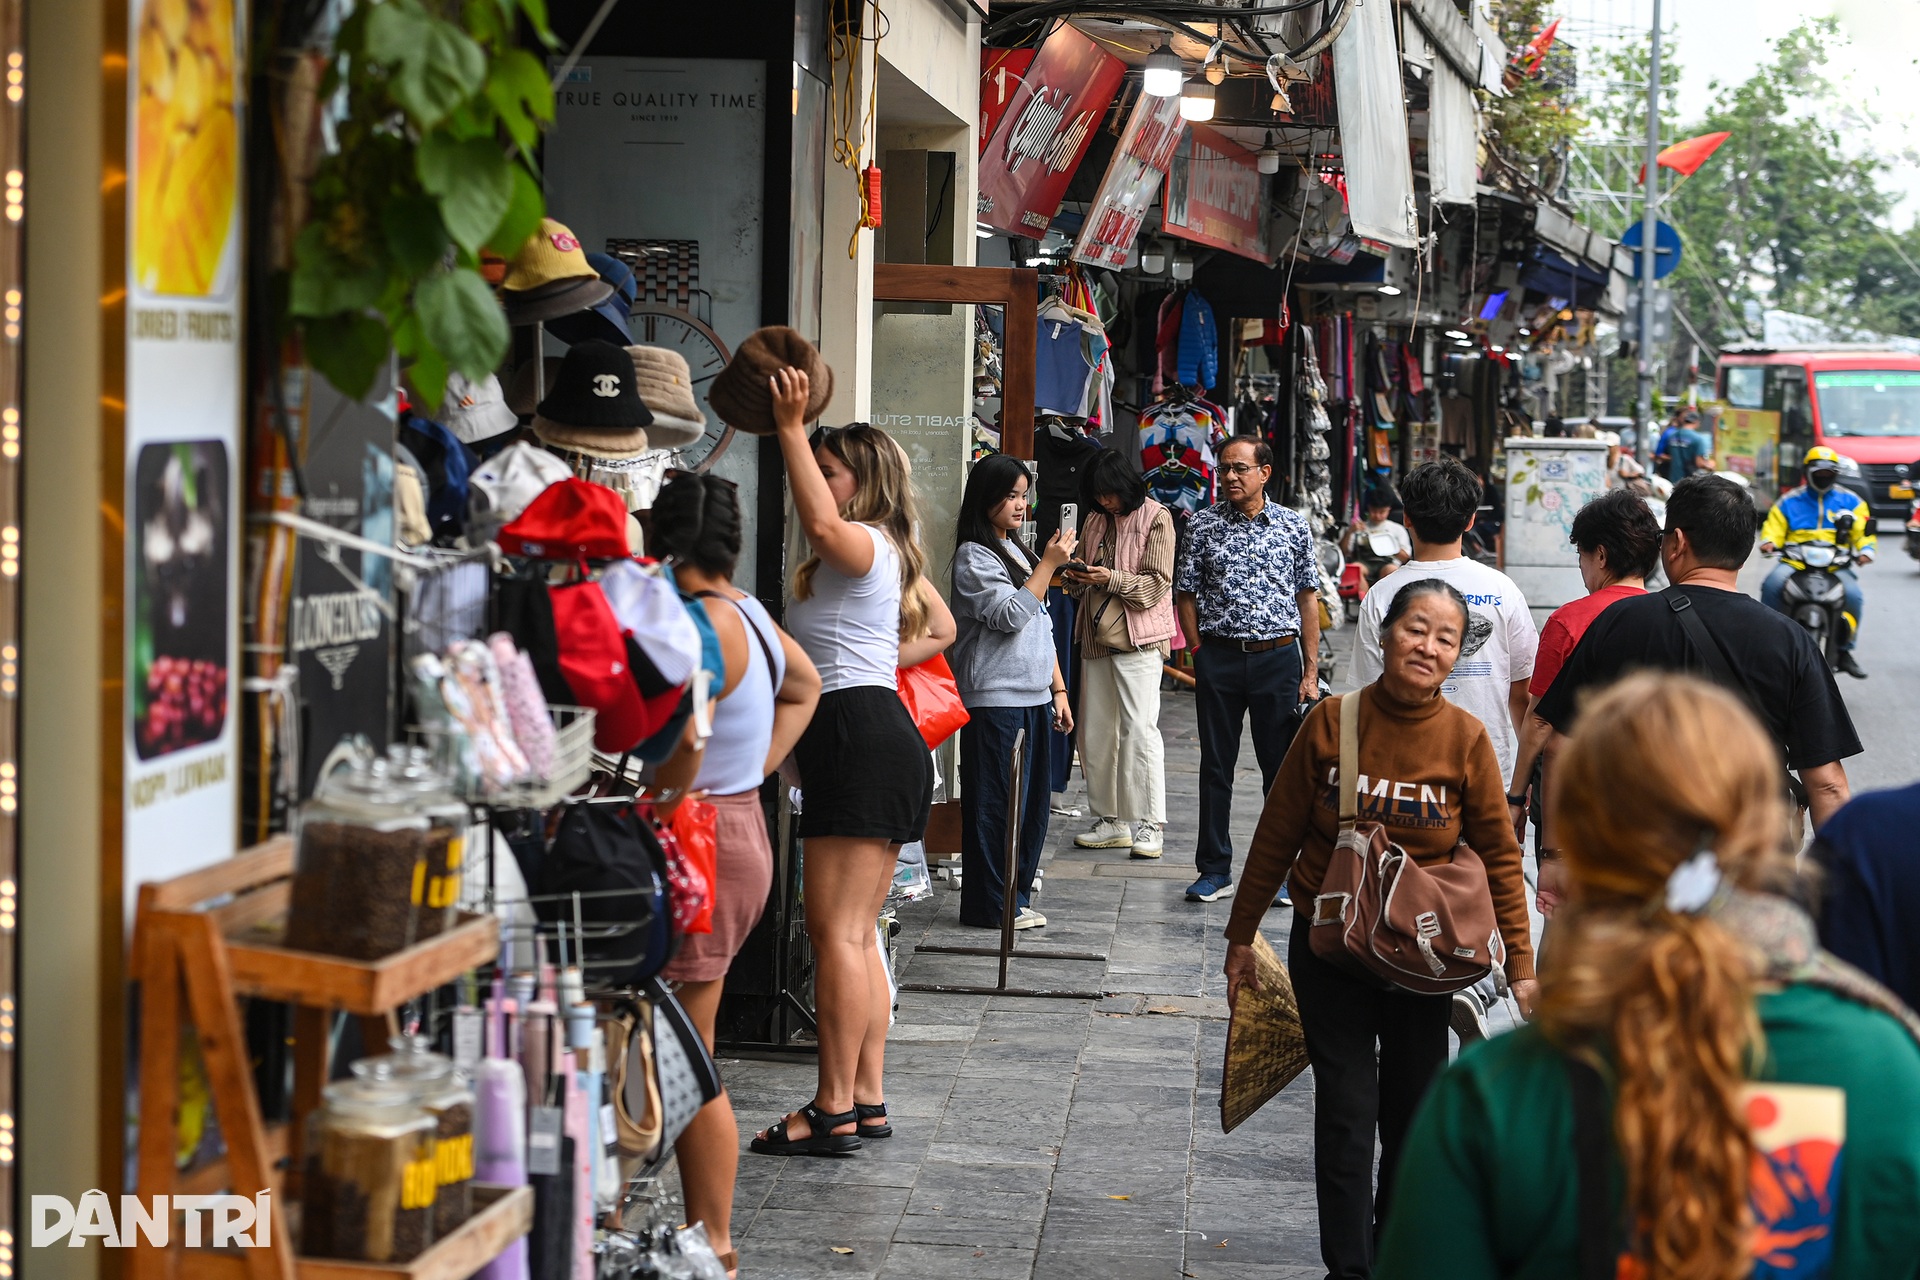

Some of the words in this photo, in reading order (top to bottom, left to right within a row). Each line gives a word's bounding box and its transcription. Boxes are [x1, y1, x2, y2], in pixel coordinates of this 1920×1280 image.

[556, 91, 602, 107] TRUE
[613, 91, 699, 108] QUALITY
[709, 93, 757, 109] TIME
[630, 114, 656, 122] SINCE
[660, 114, 679, 122] 1919
[1041, 110, 1097, 177] Anh
[1464, 594, 1502, 606] RINTS
